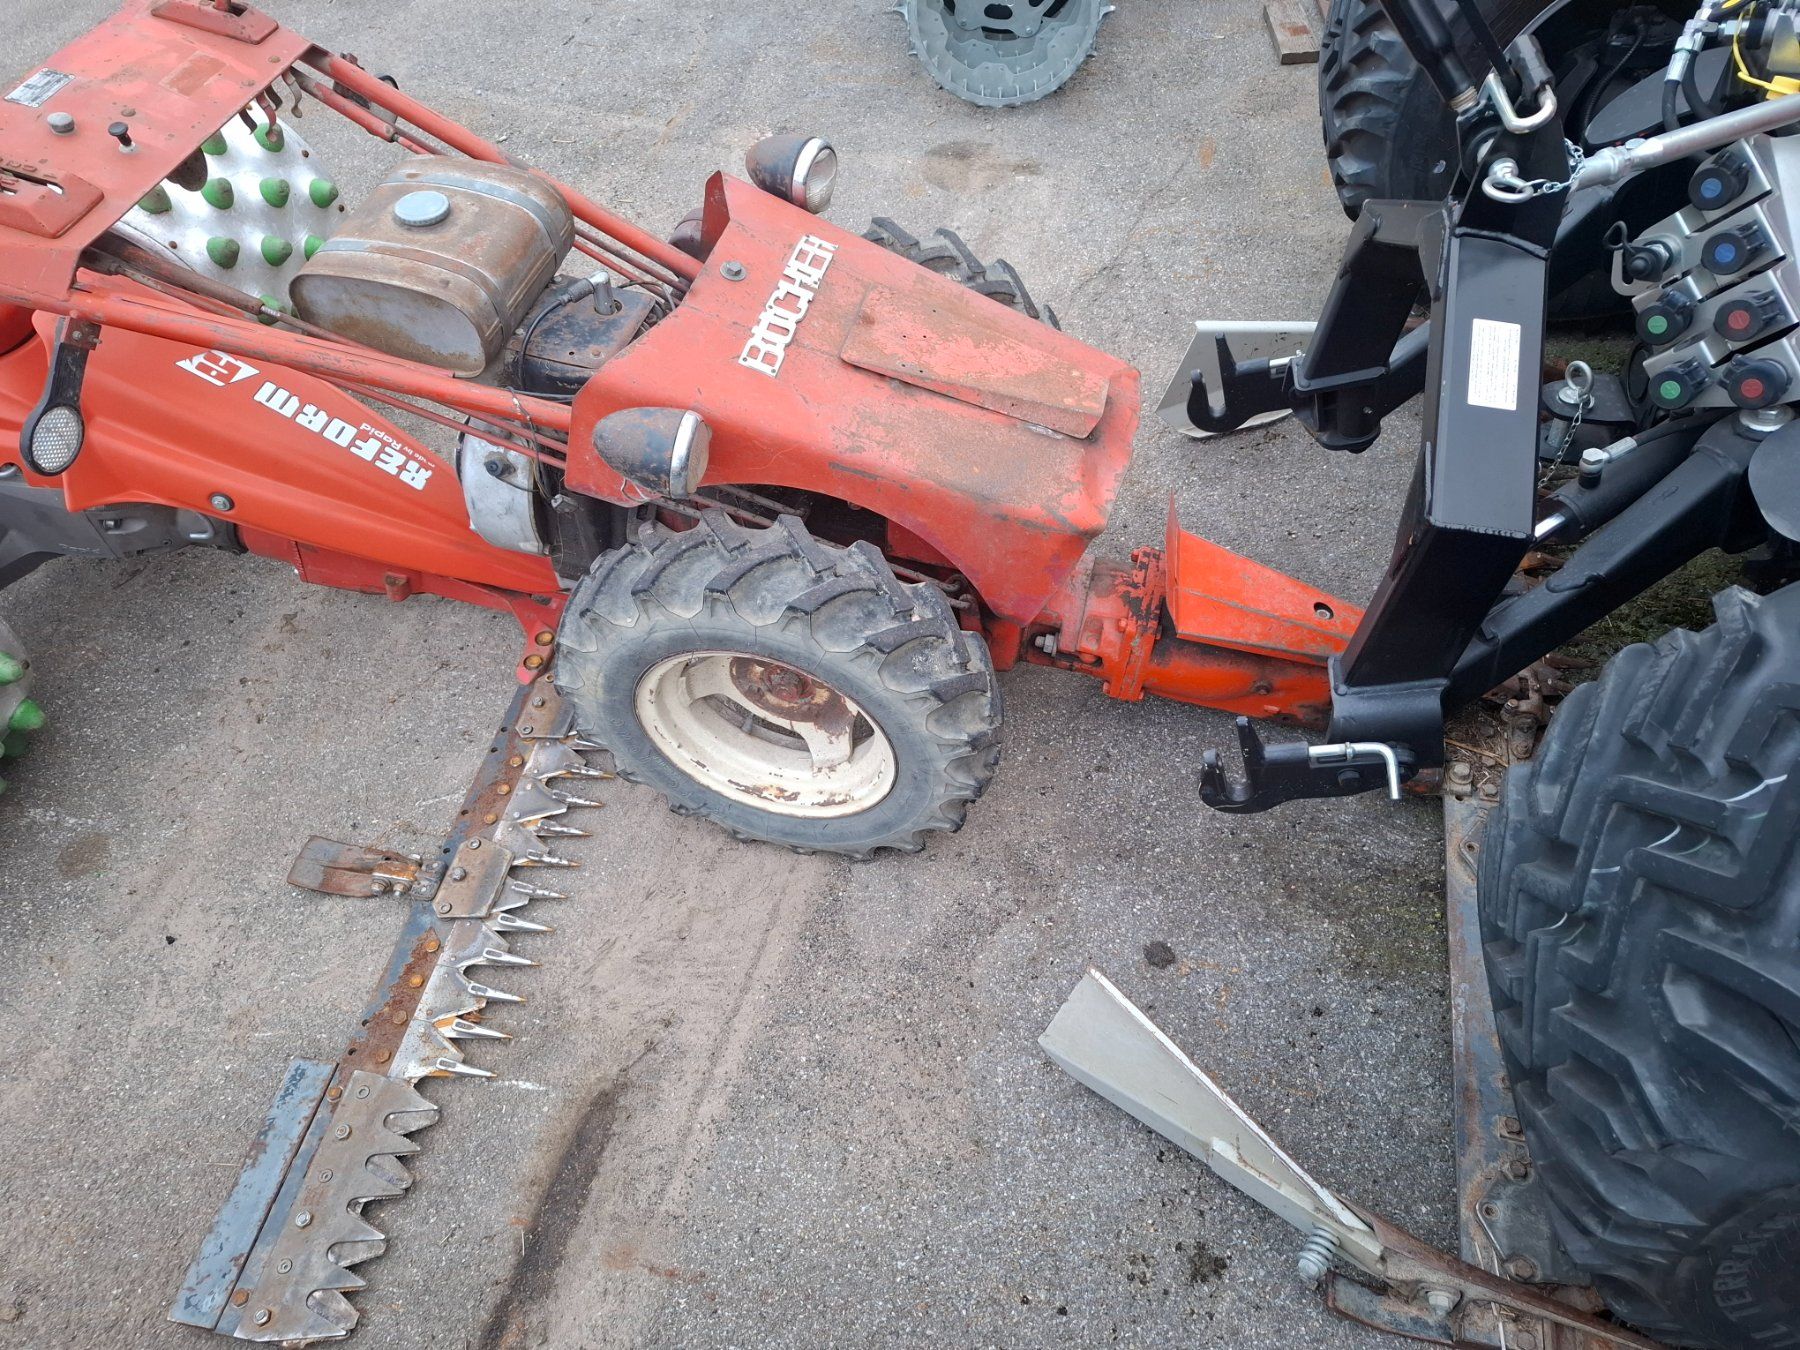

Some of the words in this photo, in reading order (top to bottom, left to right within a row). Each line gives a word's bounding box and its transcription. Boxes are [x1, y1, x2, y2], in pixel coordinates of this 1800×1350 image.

[738, 234, 839, 379] BUCHER
[253, 381, 433, 491] REFORM
[360, 423, 402, 450] Rapid
